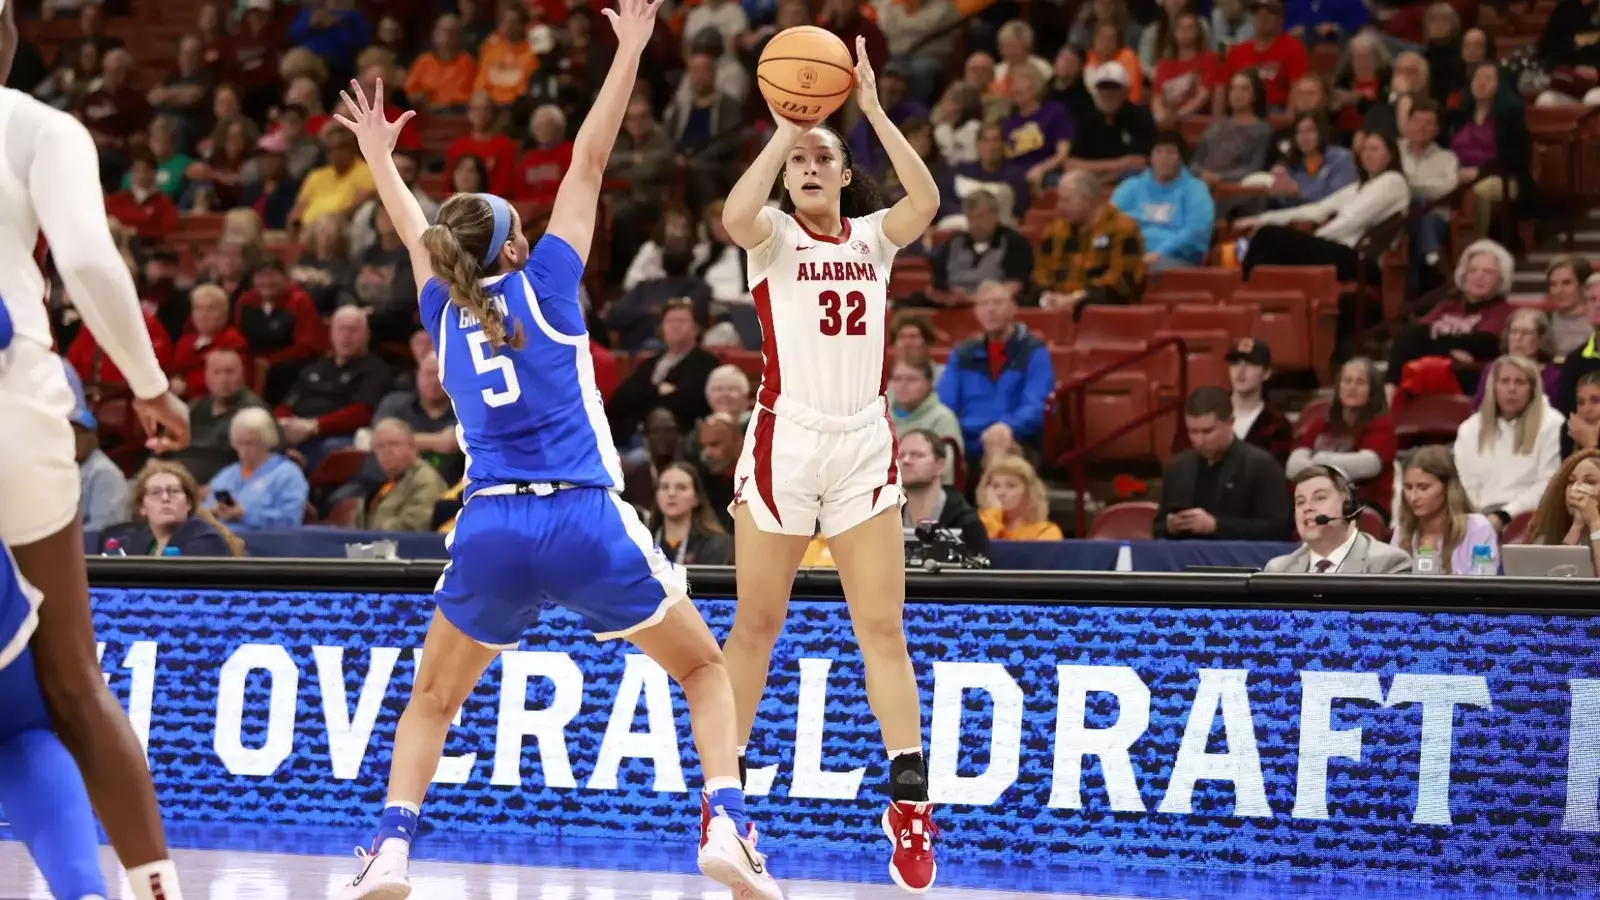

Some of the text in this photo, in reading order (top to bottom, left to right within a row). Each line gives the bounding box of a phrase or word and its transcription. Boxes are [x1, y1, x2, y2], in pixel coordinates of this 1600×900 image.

[797, 262, 877, 282] ALABAMA
[818, 290, 867, 336] 32
[466, 330, 521, 408] 5
[96, 640, 158, 772] 1
[213, 643, 867, 800] OVRAL
[928, 661, 1493, 826] DRAFT
